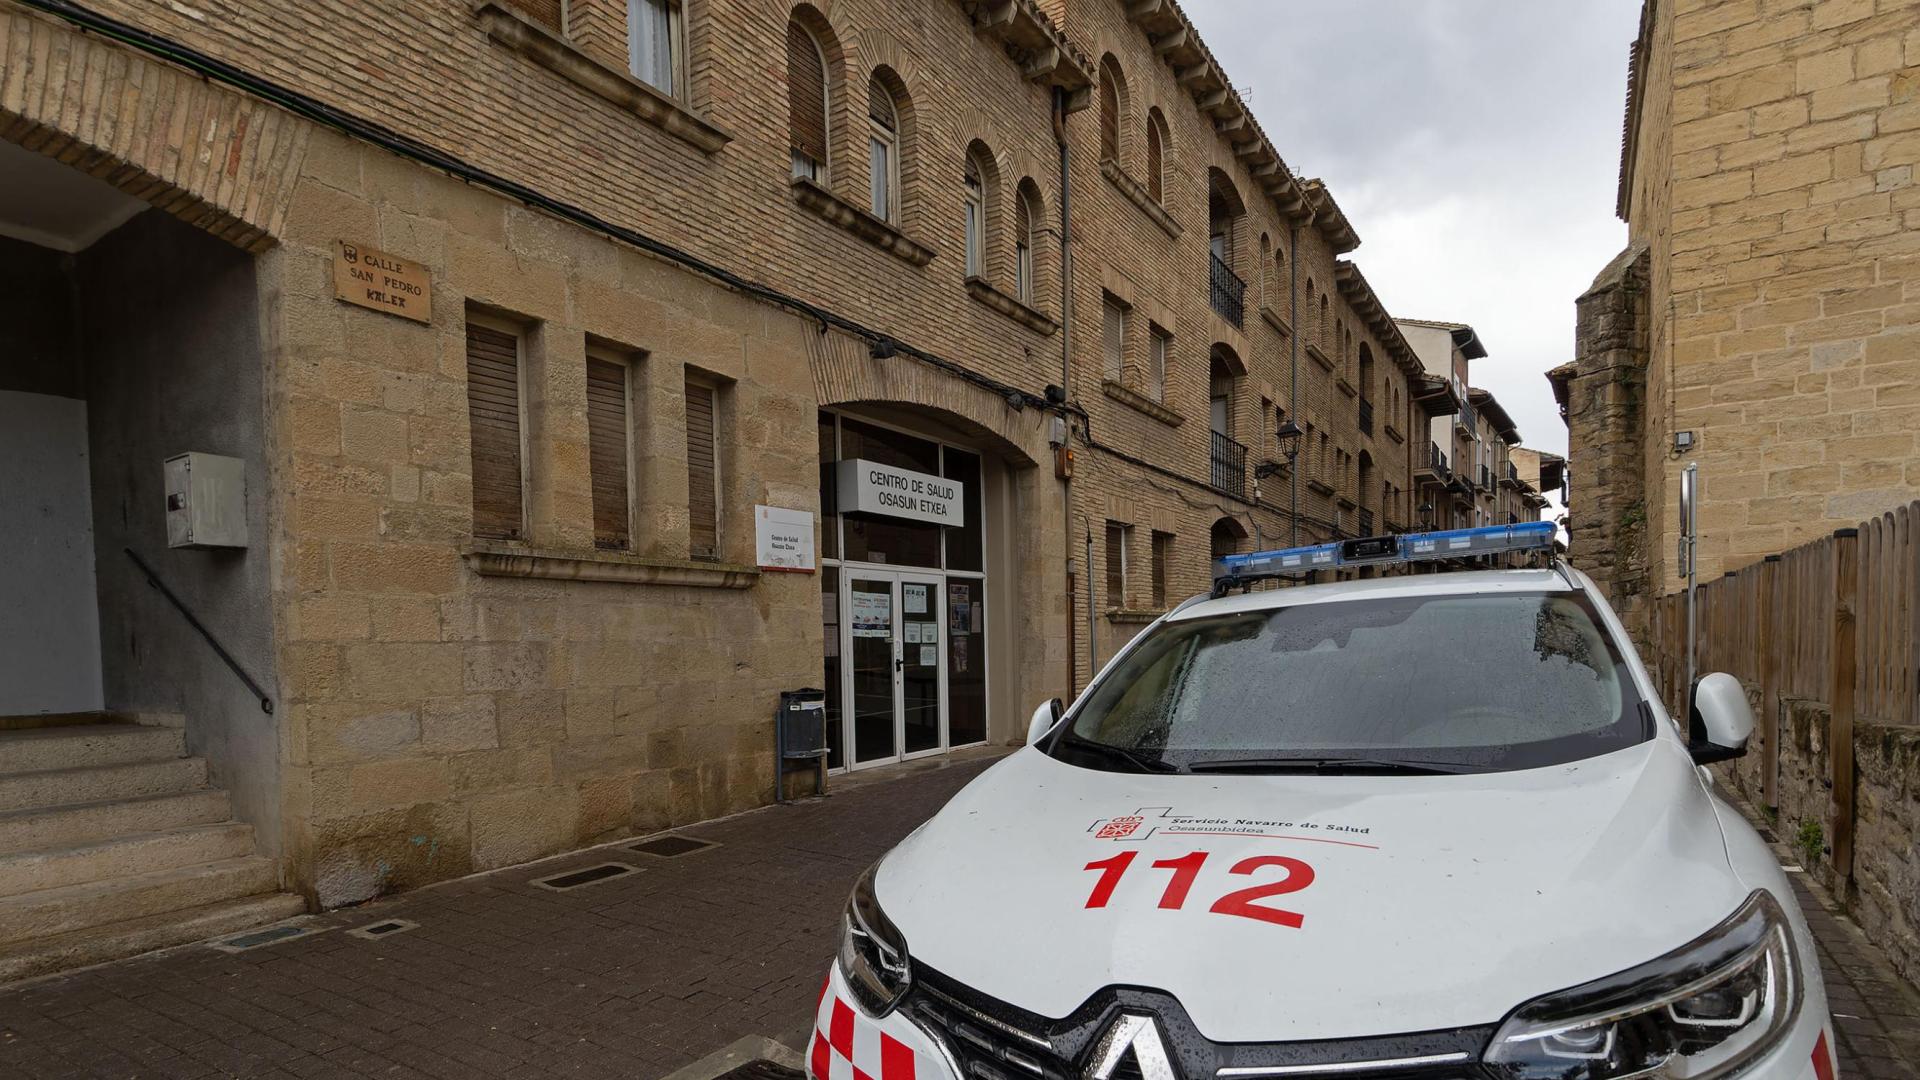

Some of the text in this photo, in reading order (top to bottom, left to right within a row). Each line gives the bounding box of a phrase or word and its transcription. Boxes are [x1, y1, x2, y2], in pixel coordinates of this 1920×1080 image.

[364, 256, 403, 273] CALLE
[350, 268, 422, 296] SAN PEDRO
[870, 470, 954, 500] CENTRO DE SALUD
[879, 491, 947, 516] OSASUN ETXEA
[1168, 825, 1265, 834] Osasunbidea
[1235, 819, 1294, 828] Navarro
[1326, 823, 1370, 835] Salud
[1083, 851, 1316, 929] 112
